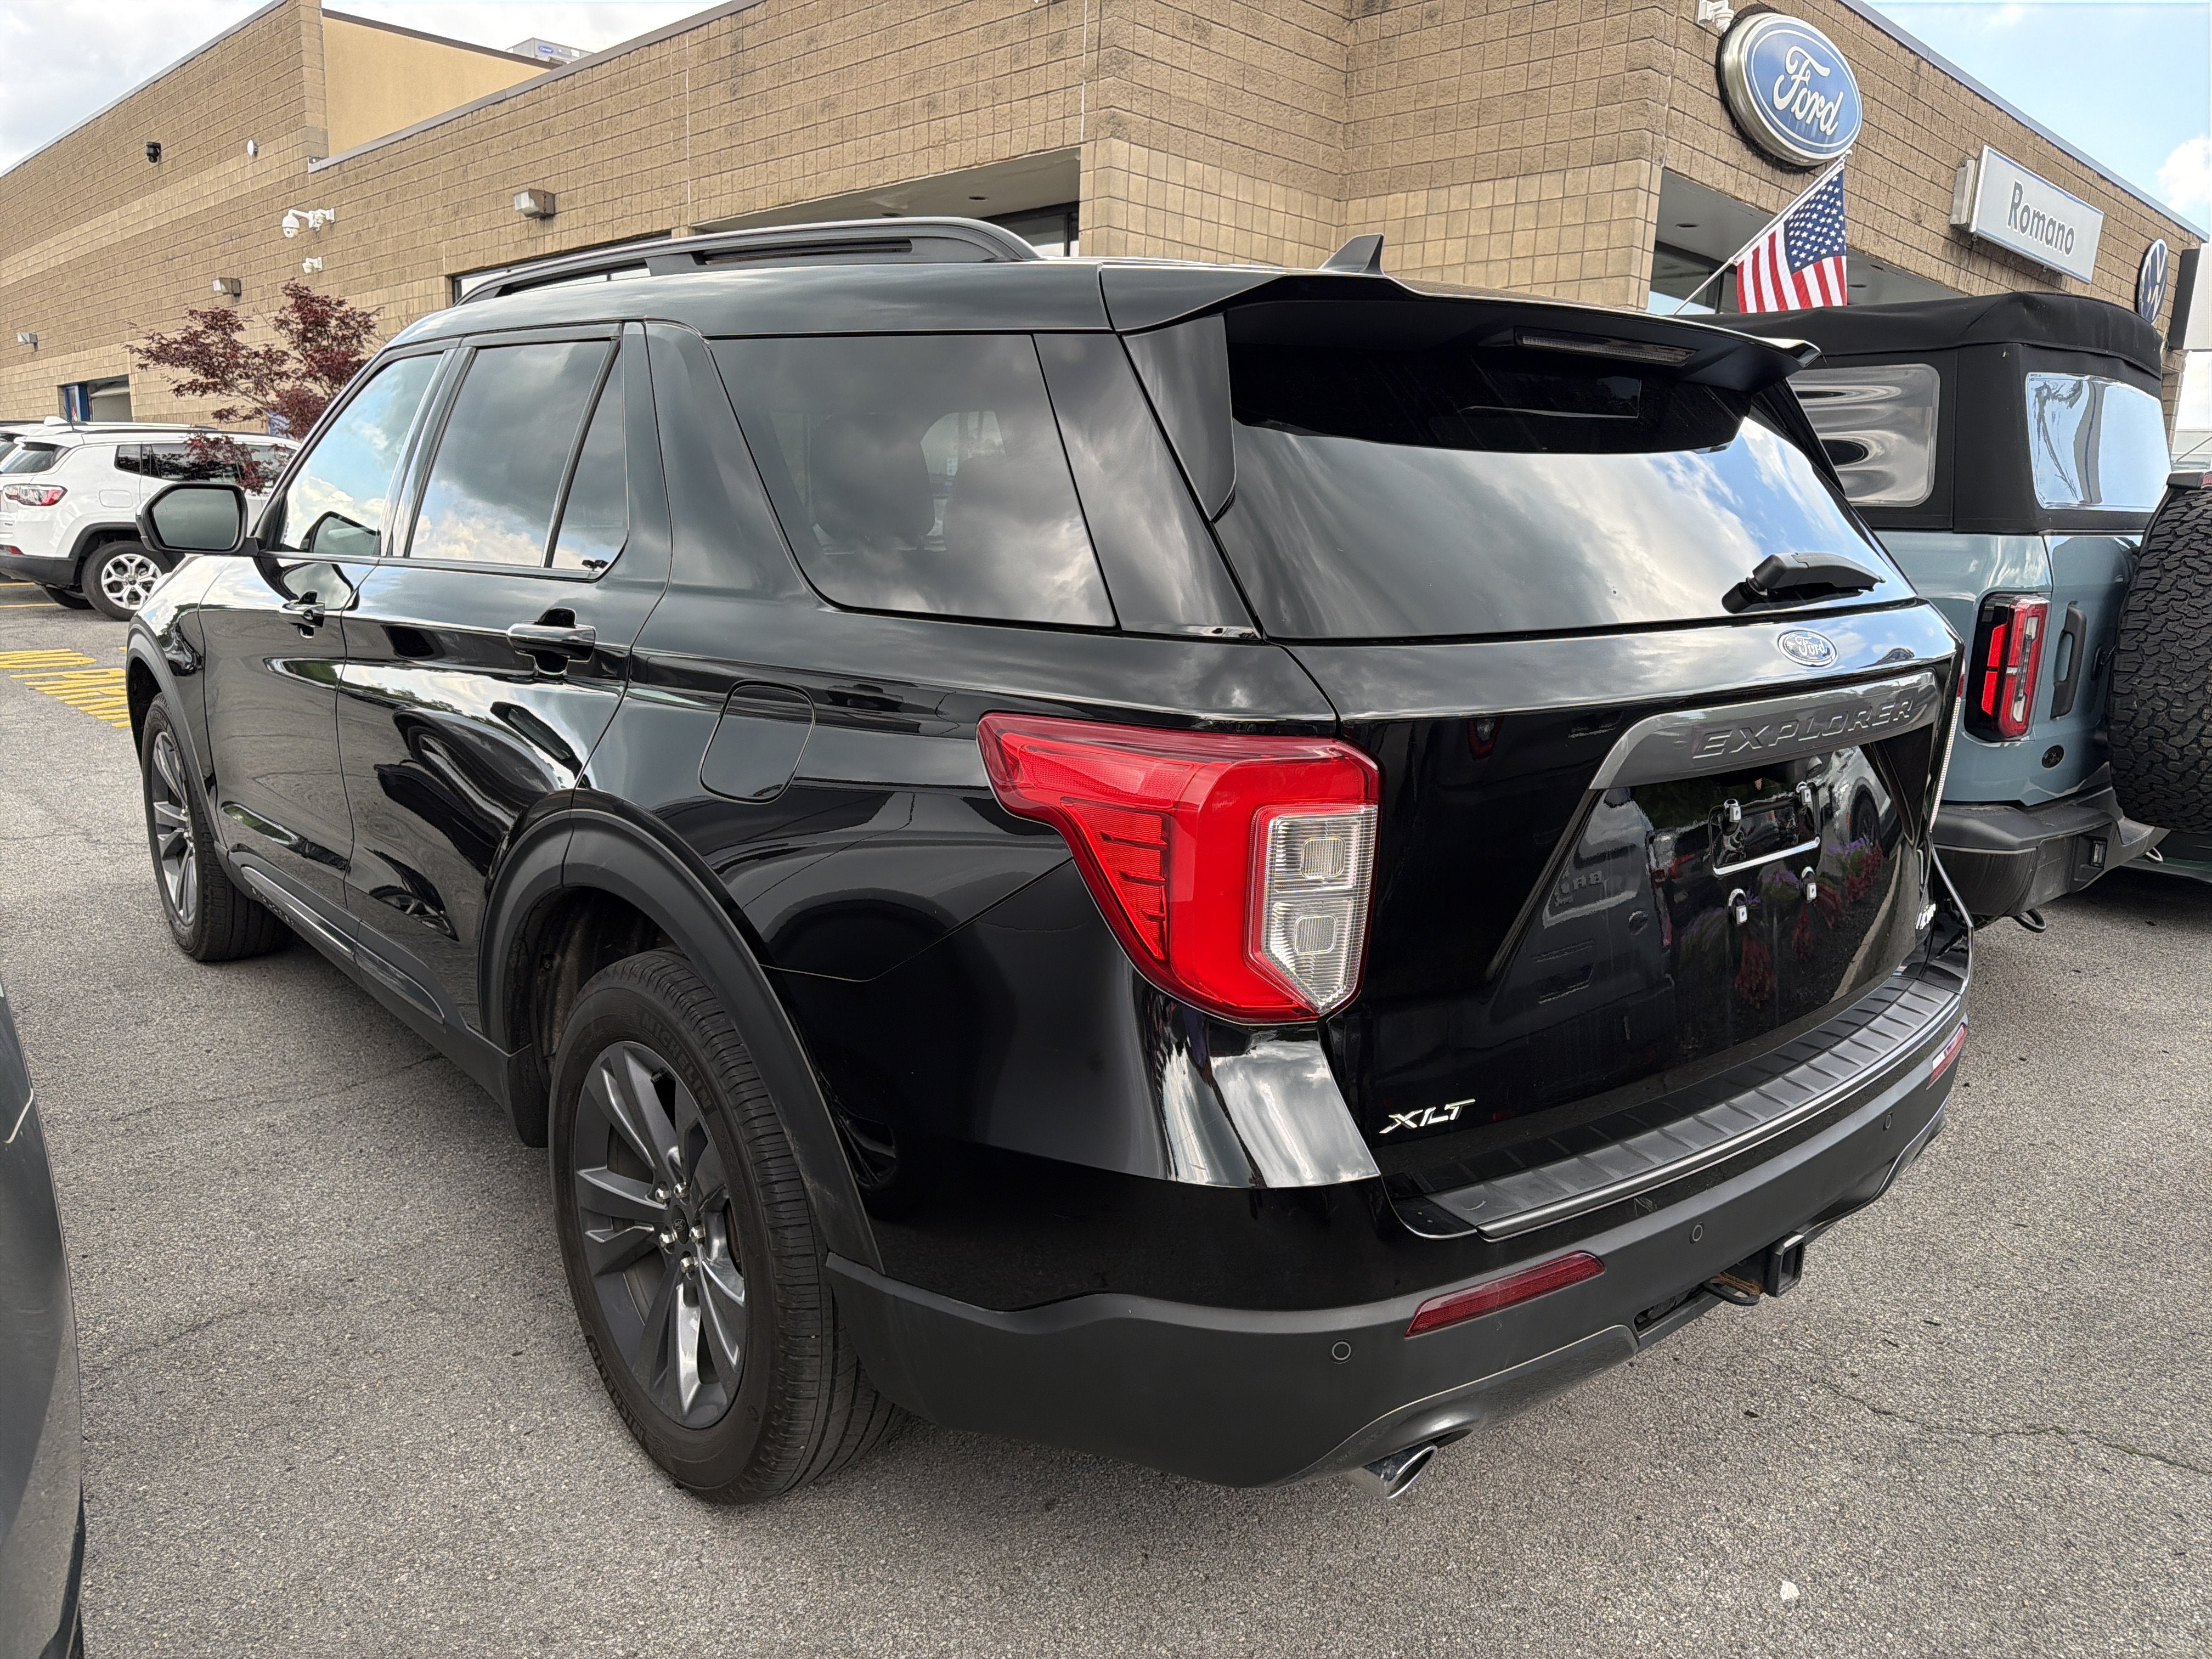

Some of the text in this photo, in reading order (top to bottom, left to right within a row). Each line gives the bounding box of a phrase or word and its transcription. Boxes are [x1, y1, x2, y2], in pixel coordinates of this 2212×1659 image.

[1773, 46, 1844, 136] Ford
[2007, 179, 2075, 257] Romano
[1795, 636, 1828, 657] Ford
[1692, 696, 1915, 760] EXPLORER
[641, 1012, 714, 1111] MICHELIN
[1379, 1098, 1476, 1134] XLT
